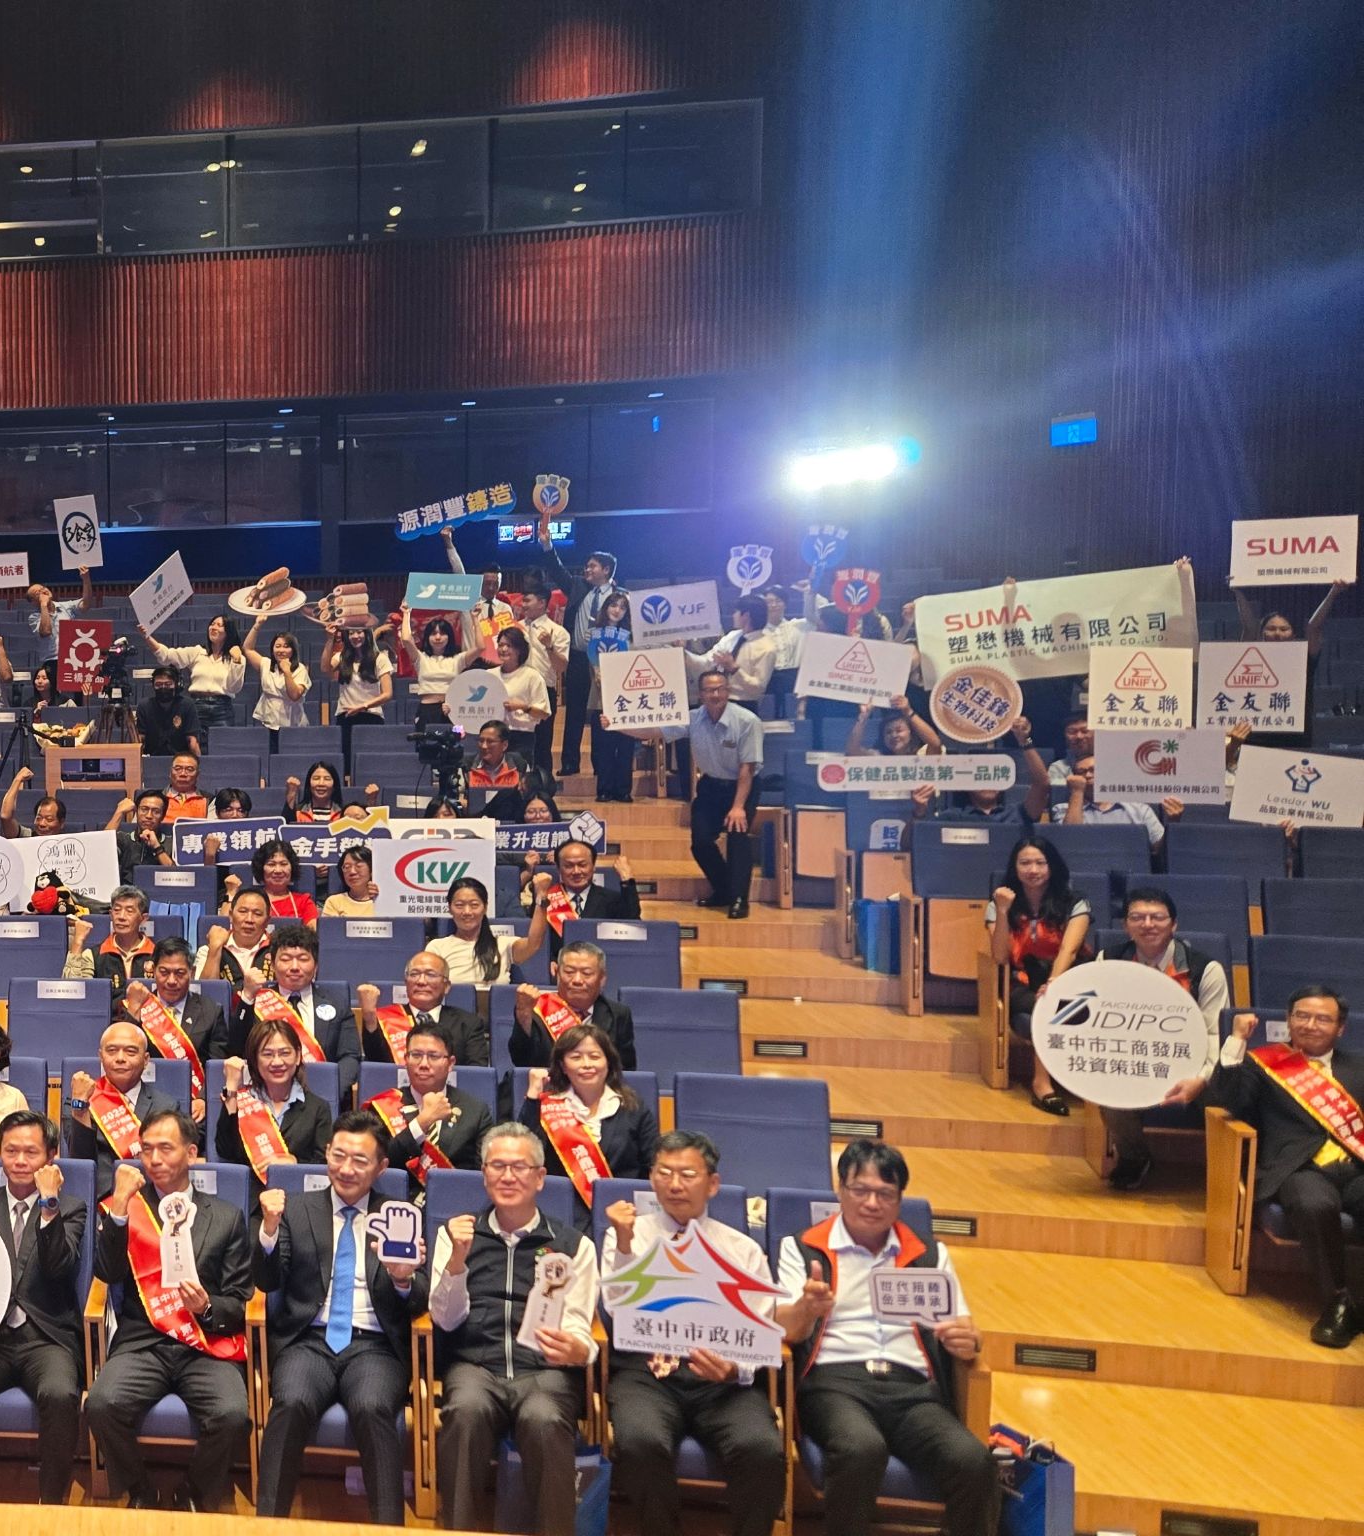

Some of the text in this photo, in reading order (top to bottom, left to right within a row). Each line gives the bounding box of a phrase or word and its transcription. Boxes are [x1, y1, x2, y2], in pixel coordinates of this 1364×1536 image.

[397, 482, 513, 533] 源潤豐鑄造
[1246, 535, 1340, 556] SUMA
[678, 603, 706, 614] YJF
[945, 605, 1033, 632] SUMA
[948, 612, 1167, 655] 塑懋機械有限公司
[949, 654, 982, 665] SUMA
[842, 661, 868, 672] UNIFY
[63, 672, 105, 683] 三橋食品
[628, 678, 657, 688] UNIFY
[828, 672, 853, 682] SINCE
[1123, 677, 1159, 688] UNIFY
[1233, 675, 1271, 686] UNIFY
[614, 694, 677, 712] 金友聯
[1102, 693, 1179, 714] 金友聯
[1212, 692, 1291, 713] 金友聯
[612, 711, 682, 725] 工業股份有限公司
[940, 691, 998, 733] 生物科技
[1097, 717, 1183, 729] 工業股份有限公司
[1206, 716, 1295, 727] 工業股份有限公司
[848, 765, 1011, 782] 保健品製造第一品牌
[1311, 800, 1331, 811] WU
[46, 844, 77, 857] 鴻鼎
[141, 1003, 158, 1015] 025
[1101, 1001, 1192, 1014] TAICHUNG CITY
[390, 1032, 407, 1042] 202
[1047, 1034, 1192, 1060] 臺中市工商發展
[1068, 1055, 1171, 1079] 投資策進會
[101, 1105, 127, 1123] 2025
[633, 1318, 756, 1347] 臺中市政府
[619, 1338, 669, 1351] TAICHUNG
